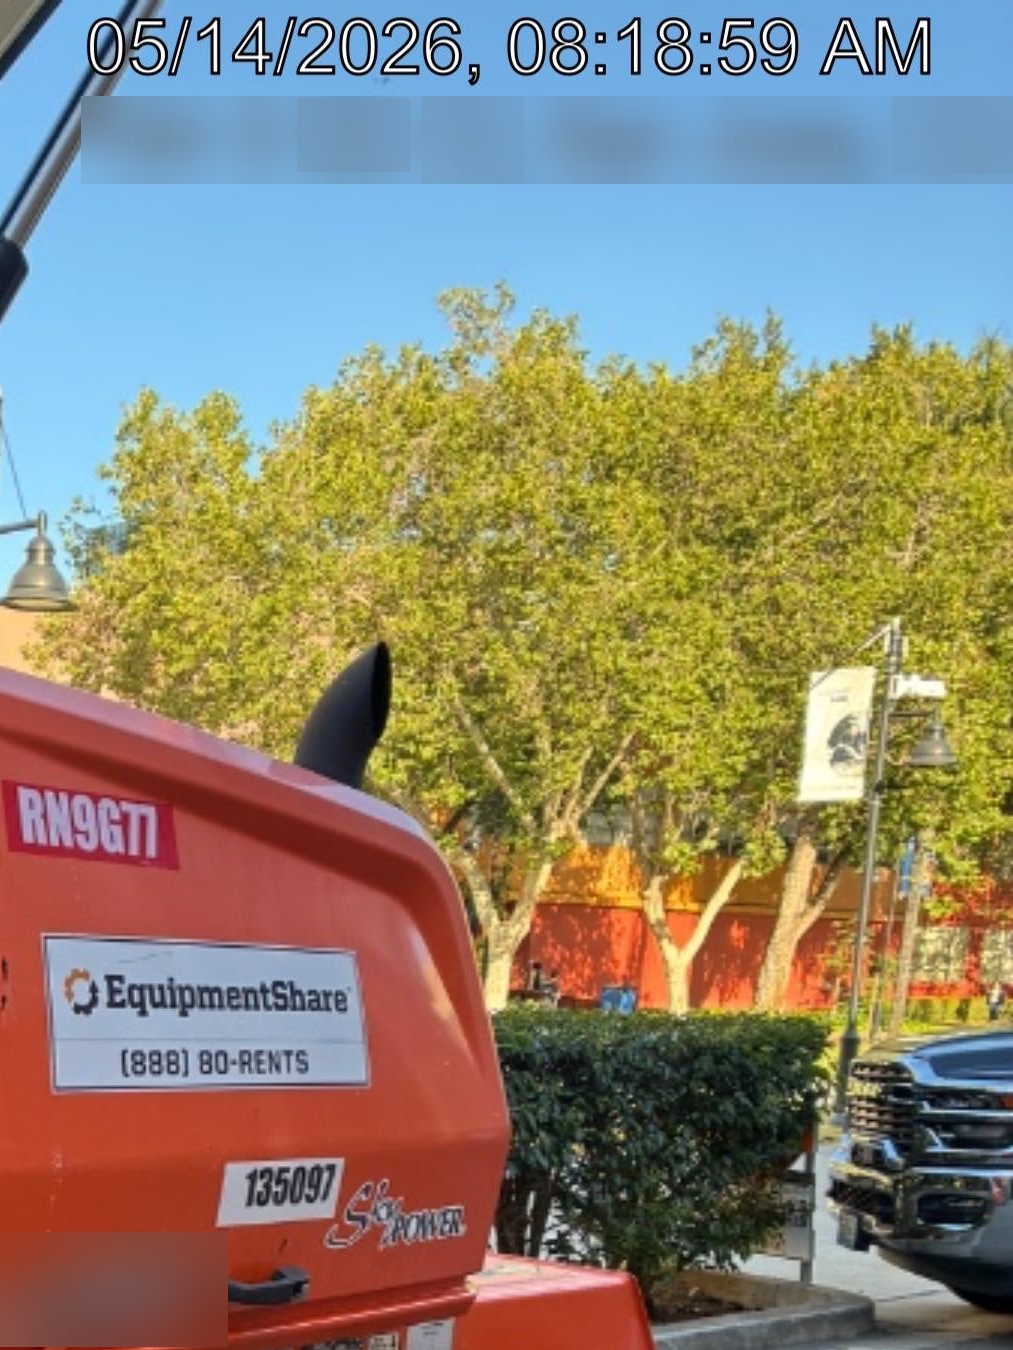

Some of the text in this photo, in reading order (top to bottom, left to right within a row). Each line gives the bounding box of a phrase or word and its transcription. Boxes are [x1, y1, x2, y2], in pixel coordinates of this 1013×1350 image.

[16, 784, 158, 860] RN9G77
[103, 973, 349, 1017] EquipmentShare
[120, 1048, 310, 1078] (888) 80-RENTS
[244, 1163, 337, 1208] 135097
